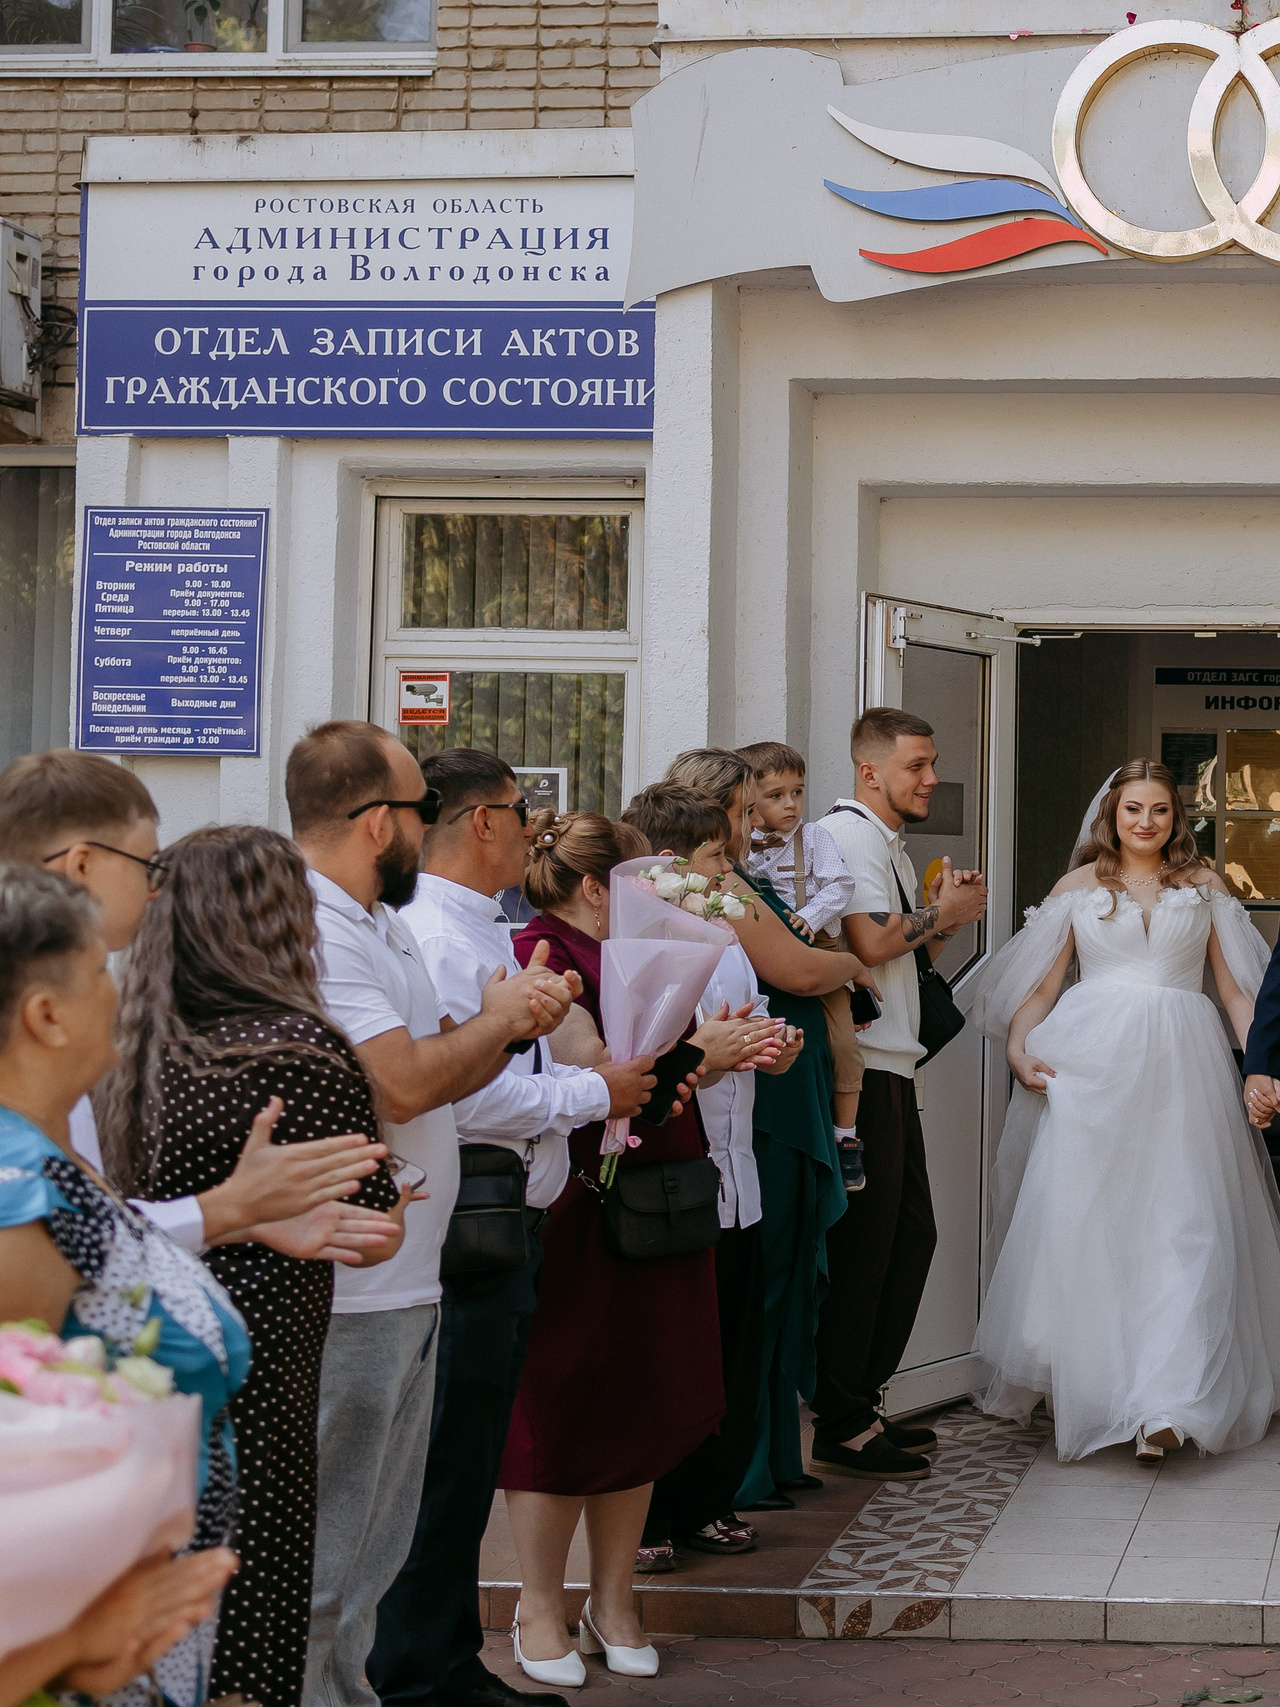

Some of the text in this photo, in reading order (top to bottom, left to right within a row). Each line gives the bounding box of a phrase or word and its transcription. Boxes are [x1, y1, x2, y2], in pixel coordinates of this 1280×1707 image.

[254, 198, 544, 214] РОСТОВСКАЯ ОБЛАСТЬ
[193, 226, 610, 255] АДМИНИСТРАЦИЯ
[193, 255, 611, 287] города Волгодонска
[153, 326, 640, 360] ОТДЕЛ ЗАПИСИ АКТОВ
[105, 376, 426, 410] ГРАЖДАНСКОГО
[94, 516, 256, 528] Отдел записи актов гражданского состояния
[109, 528, 241, 540] Администрации города Волгодонска
[138, 540, 210, 551] Ростовской области
[126, 560, 228, 574] Режим работы
[96, 581, 135, 591] Вторник
[185, 580, 202, 588] 9.00
[211, 580, 231, 589] 18.00
[101, 592, 129, 603] Среда
[170, 589, 245, 599] Приём документов:
[95, 603, 134, 615] Пятница
[184, 599, 201, 607] 9.00
[210, 599, 230, 608] 17.00
[163, 609, 199, 618] перерыв:
[201, 609, 222, 617] 13.00
[231, 609, 250, 618] 13.45
[94, 626, 132, 636] Четверг
[221, 629, 240, 638] день
[182, 646, 199, 655] 9.00
[208, 646, 228, 655] 16.45
[94, 656, 132, 667] Суббота
[167, 655, 242, 666] Приём документов:
[181, 665, 198, 674] 9.00
[207, 665, 227, 674] 15.00
[160, 675, 197, 684] перерыв:
[199, 675, 220, 683] 13.00
[228, 676, 248, 684] 13.45
[1187, 671, 1227, 683] ОТДЕЛ
[1231, 672, 1259, 683] ЗАГС
[93, 691, 146, 702] Воскресенье
[92, 702, 146, 713] Понедельник
[171, 699, 236, 709] Выходные дни
[89, 725, 135, 734] Последний
[137, 726, 158, 735] день
[161, 726, 192, 735] месяца
[115, 735, 219, 745] приём граждан до 13.00
